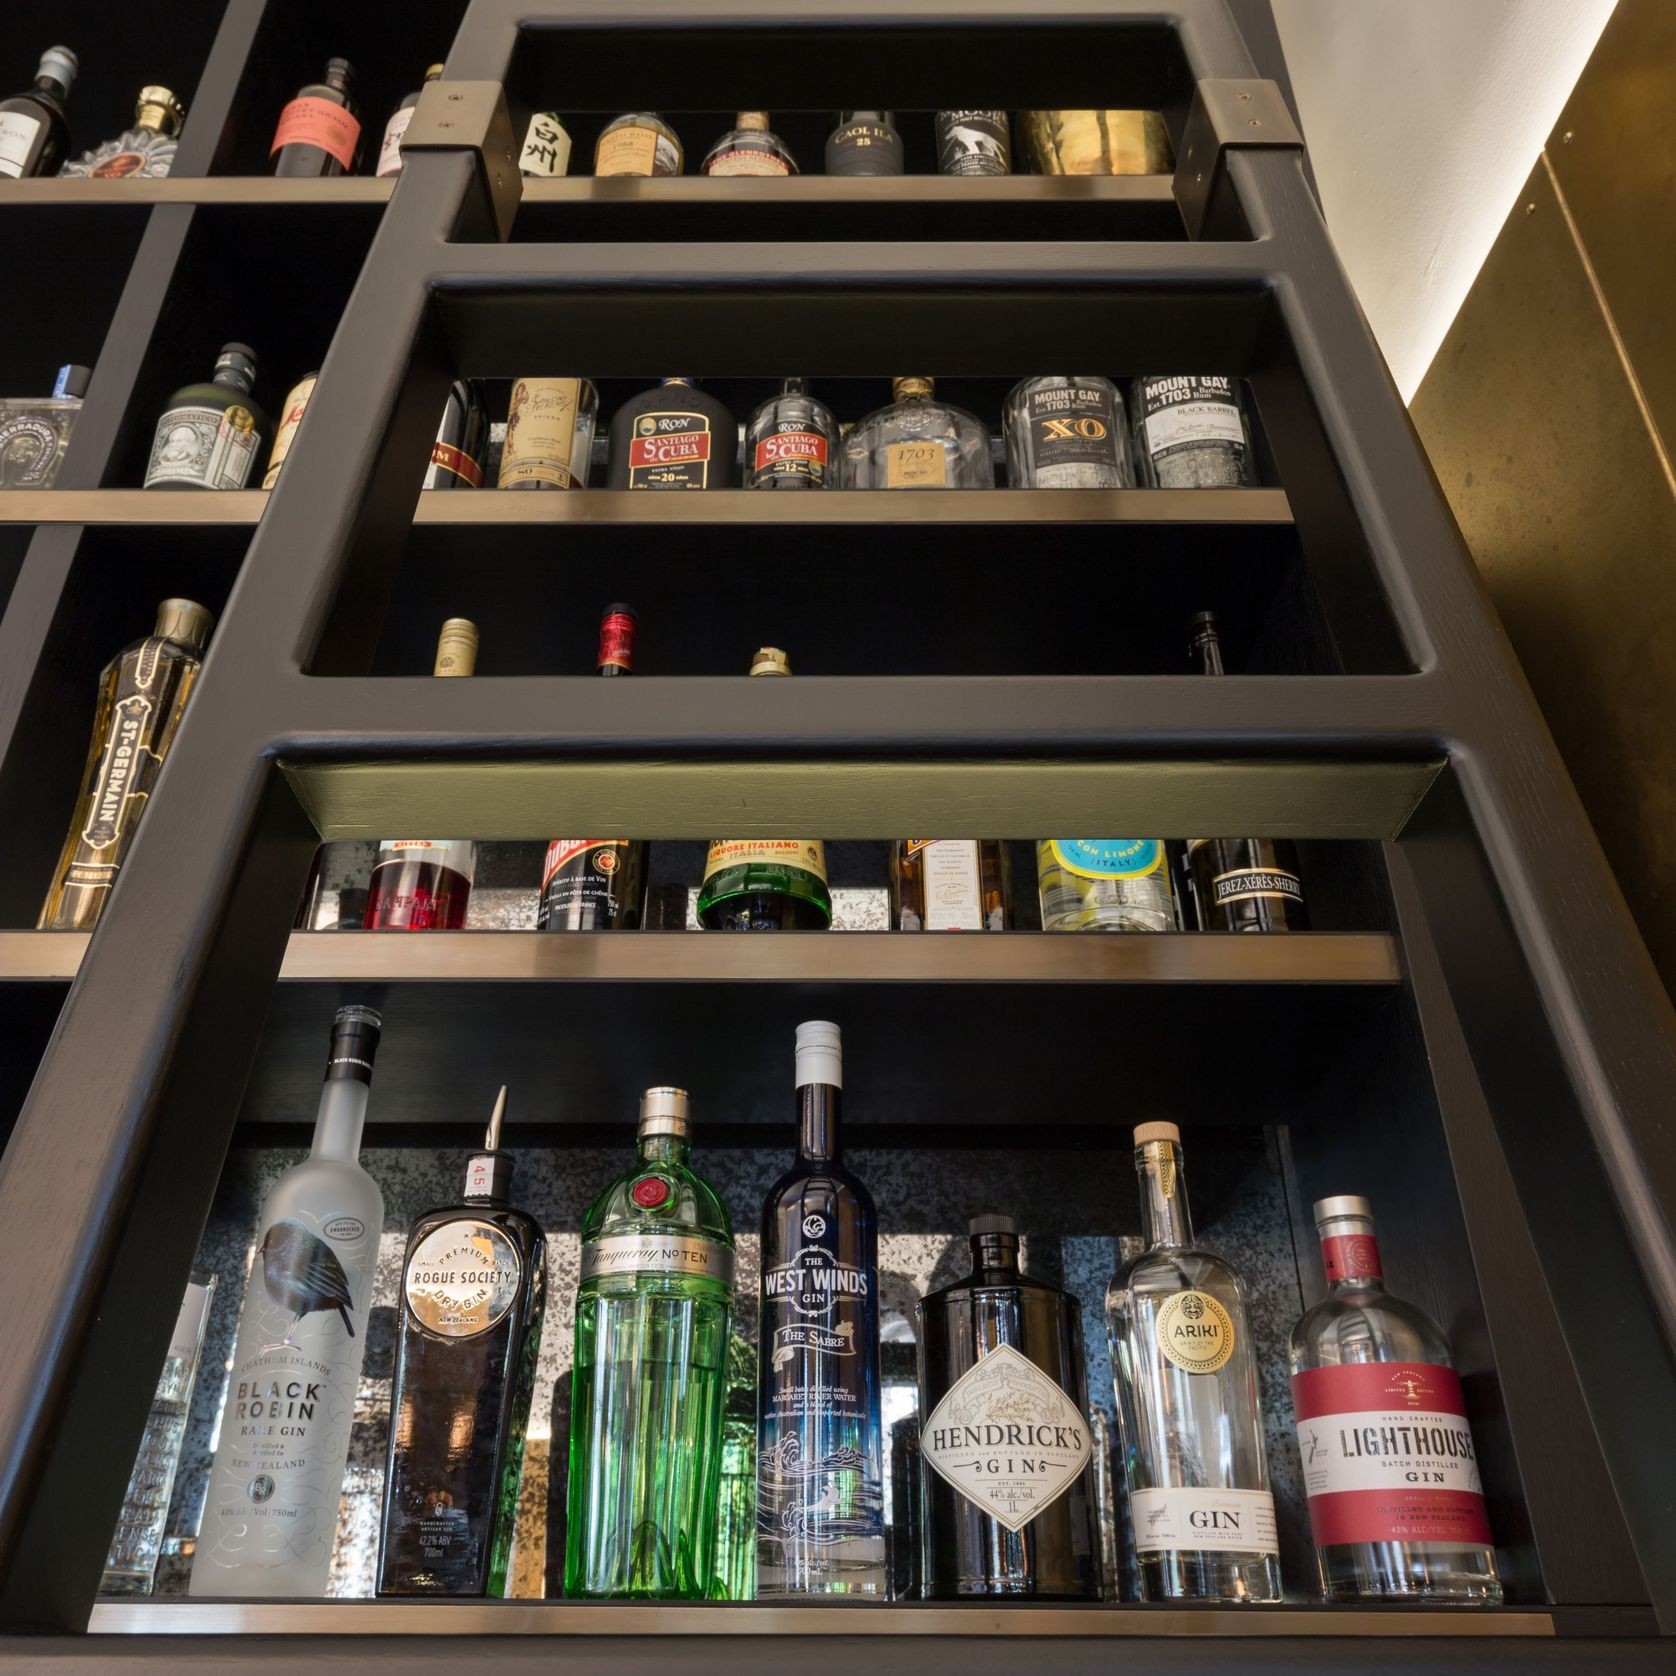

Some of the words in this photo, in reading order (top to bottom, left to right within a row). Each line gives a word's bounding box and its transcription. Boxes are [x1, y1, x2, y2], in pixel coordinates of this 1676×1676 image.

[835, 127, 870, 145] CAOL
[873, 127, 894, 143] ILA
[856, 138, 871, 147] 25
[526, 122, 559, 174] 白州
[1145, 376, 1197, 400] MOUNT
[1201, 376, 1229, 389] GAY
[1160, 388, 1191, 405] 1703
[1199, 386, 1232, 397] Barbados
[1192, 391, 1212, 399] Rum
[1034, 389, 1077, 405] MOUNT
[1078, 390, 1101, 402] GAY
[1046, 400, 1071, 411] 1703
[658, 417, 691, 431] RON
[778, 422, 806, 432] RON
[1041, 418, 1107, 442] XO
[643, 434, 699, 459] SANTIAGO
[658, 443, 699, 462] CUBA
[766, 436, 818, 459] SANTIAGO
[779, 443, 817, 458] CUBA
[899, 447, 935, 462] 1703
[785, 463, 797, 472] 12
[661, 473, 675, 482] 20
[710, 843, 745, 859] LIQUORE
[747, 841, 799, 852] ITALIANO
[1077, 840, 1099, 856] CON
[439, 1247, 489, 1265] PREMIUM
[682, 1250, 708, 1264] TEN
[805, 1258, 823, 1266] THE
[414, 1271, 455, 1284] ROGUE
[461, 1271, 512, 1284] SOCIETY
[765, 1269, 806, 1296] WEST
[812, 1268, 868, 1296] WINDS
[434, 1289, 460, 1309] DRY
[463, 1288, 487, 1309] GIN
[802, 1293, 825, 1303] GIN
[1174, 1325, 1218, 1338] ARIKI
[290, 1357, 331, 1376] ISLANDS
[238, 1381, 320, 1401] BLACK
[833, 1393, 857, 1402] WATER
[280, 1426, 306, 1437] GIN
[933, 1425, 1082, 1451] HENDRICK'S
[1340, 1426, 1475, 1461] LIGHTHOUSE
[987, 1459, 1035, 1474] GIN
[1416, 1461, 1459, 1469] DISTILLED
[1405, 1472, 1446, 1483] GIN
[1007, 1488, 1035, 1500] alc./vol.
[1008, 1501, 1019, 1513] 1L
[1189, 1510, 1241, 1529] GIN
[438, 1535, 452, 1545] ABV
